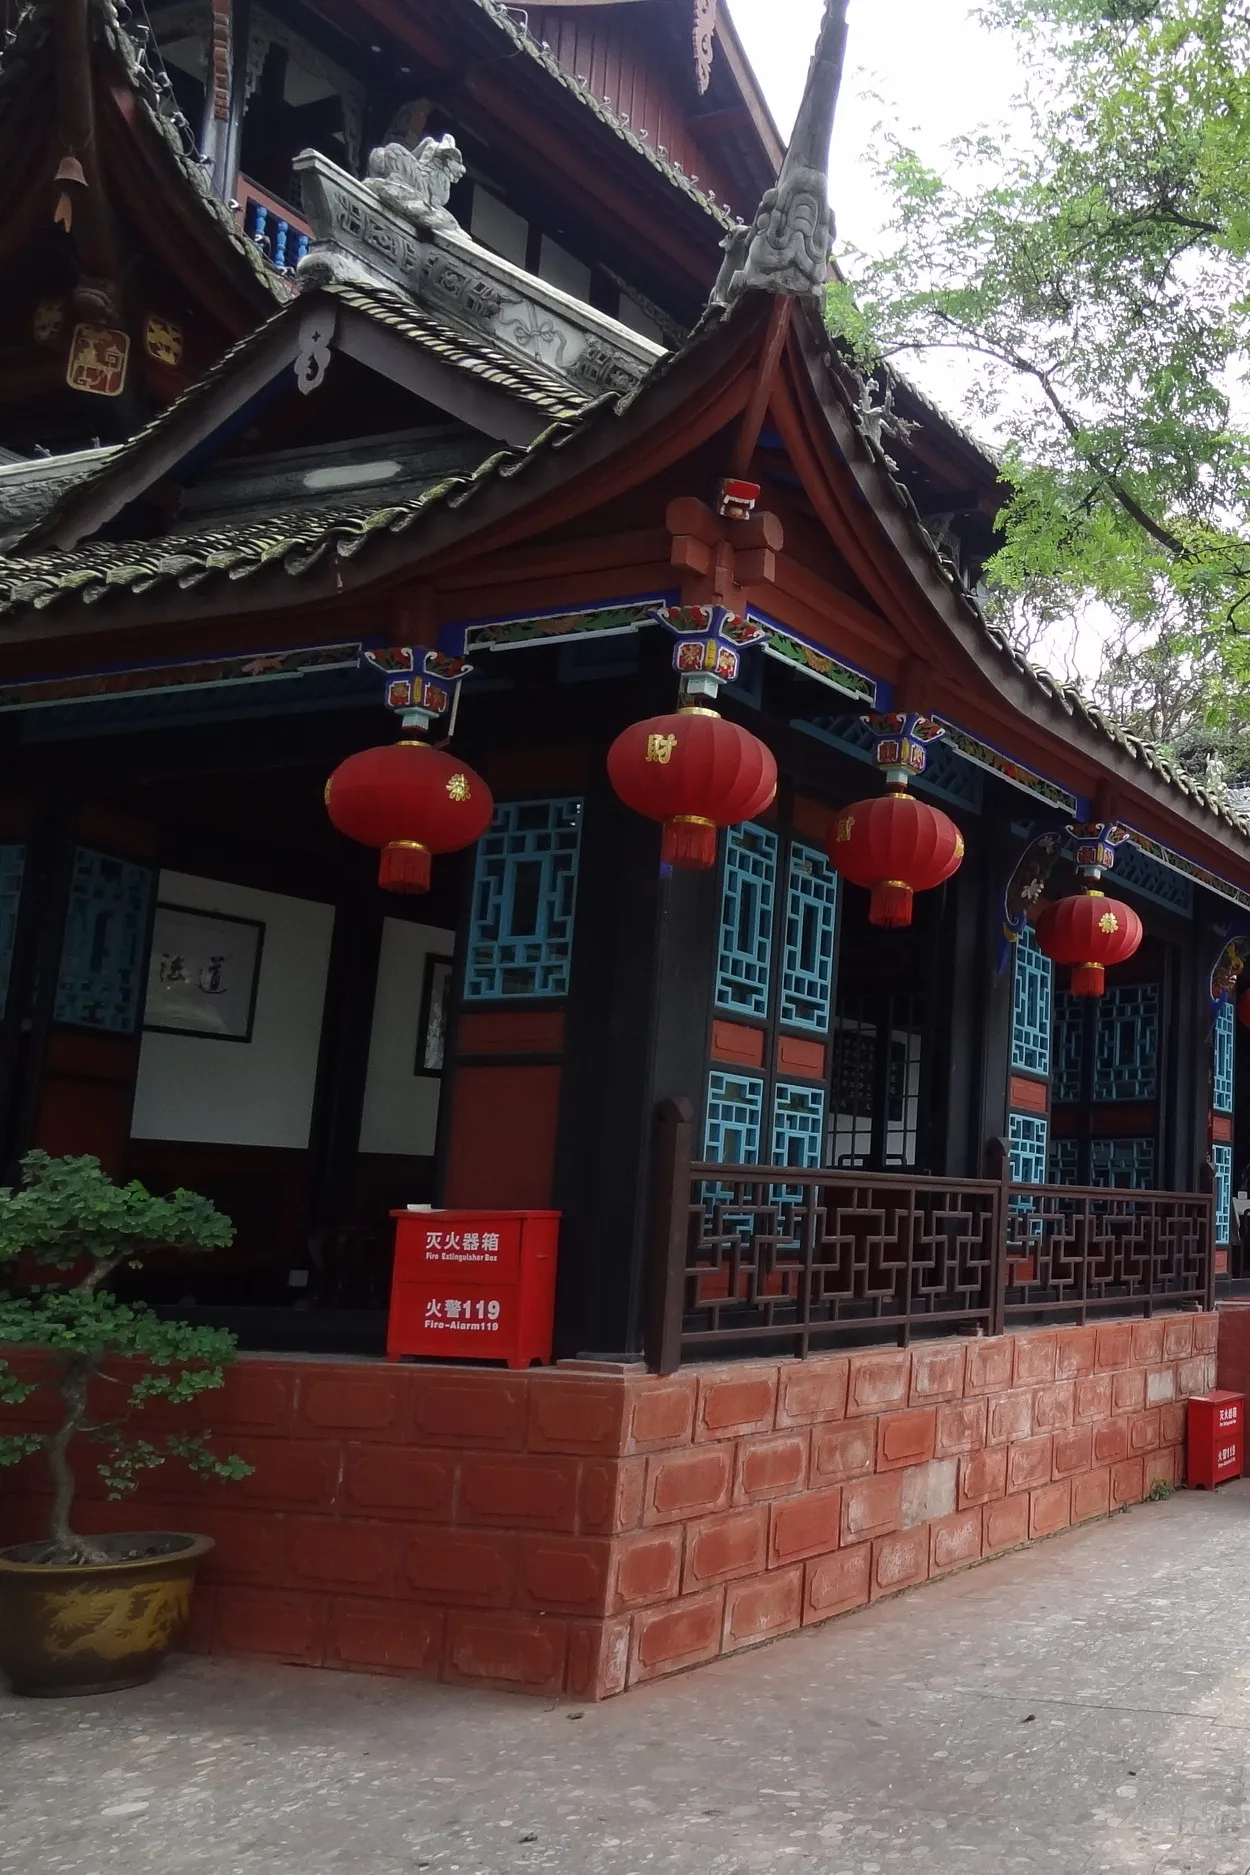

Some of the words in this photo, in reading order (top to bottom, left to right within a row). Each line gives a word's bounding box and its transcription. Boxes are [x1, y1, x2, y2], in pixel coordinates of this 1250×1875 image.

[645, 733, 677, 763] 財
[425, 1232, 500, 1251] 灭火器箱
[425, 1252, 439, 1260] Fire
[441, 1253, 484, 1263] Extinguisher
[485, 1254, 498, 1262] Box
[425, 1299, 500, 1319] 火警119
